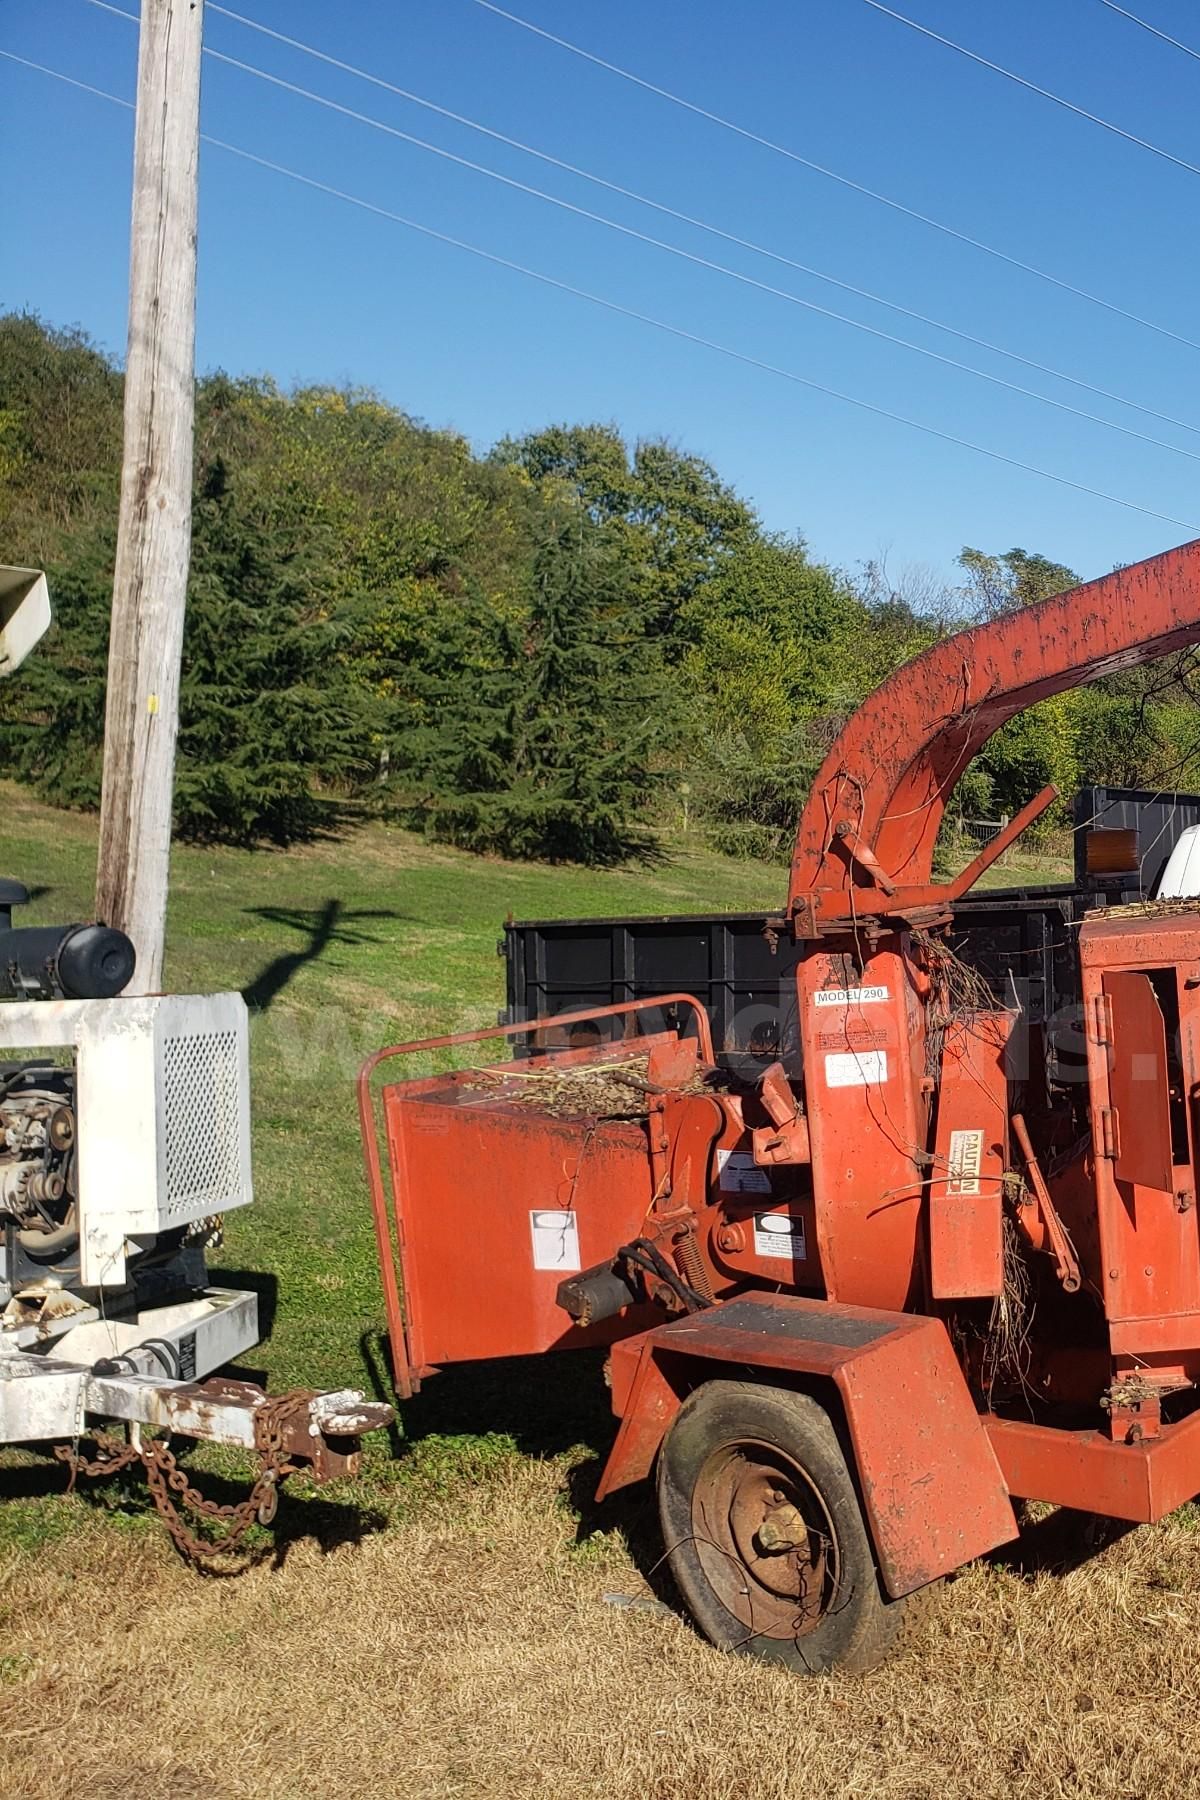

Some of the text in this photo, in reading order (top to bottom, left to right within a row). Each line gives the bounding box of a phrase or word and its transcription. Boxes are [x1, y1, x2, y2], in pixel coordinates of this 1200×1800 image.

[817, 988, 884, 1003] MODEL 290
[962, 1133, 979, 1191] CAUTION
